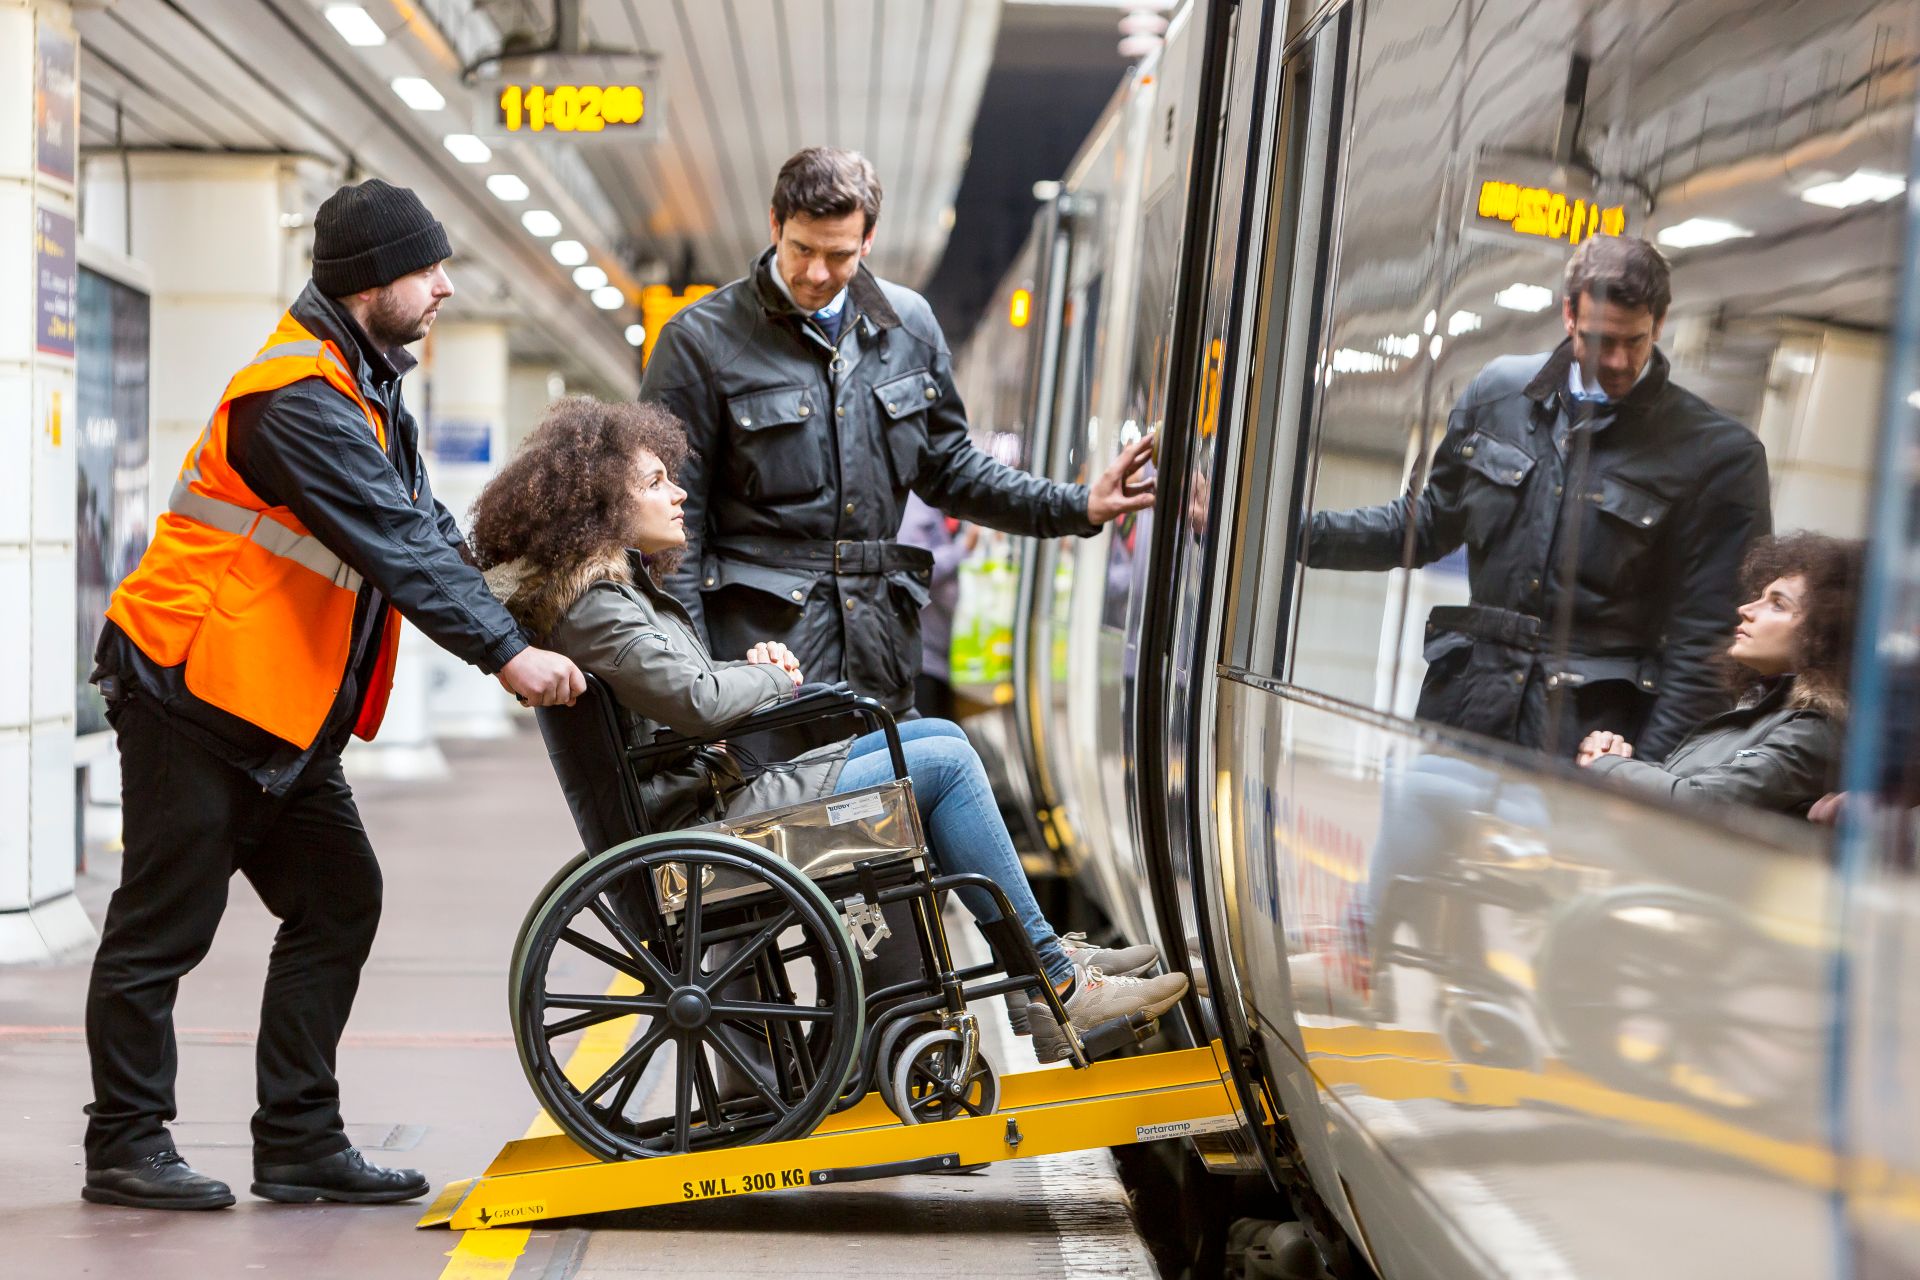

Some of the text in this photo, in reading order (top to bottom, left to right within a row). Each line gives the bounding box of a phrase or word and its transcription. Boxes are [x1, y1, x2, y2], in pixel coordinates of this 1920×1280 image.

[1137, 1122, 1190, 1135] Portaramp
[683, 1168, 805, 1200] S.W.L. 300 KG
[494, 1206, 544, 1219] GROUND
